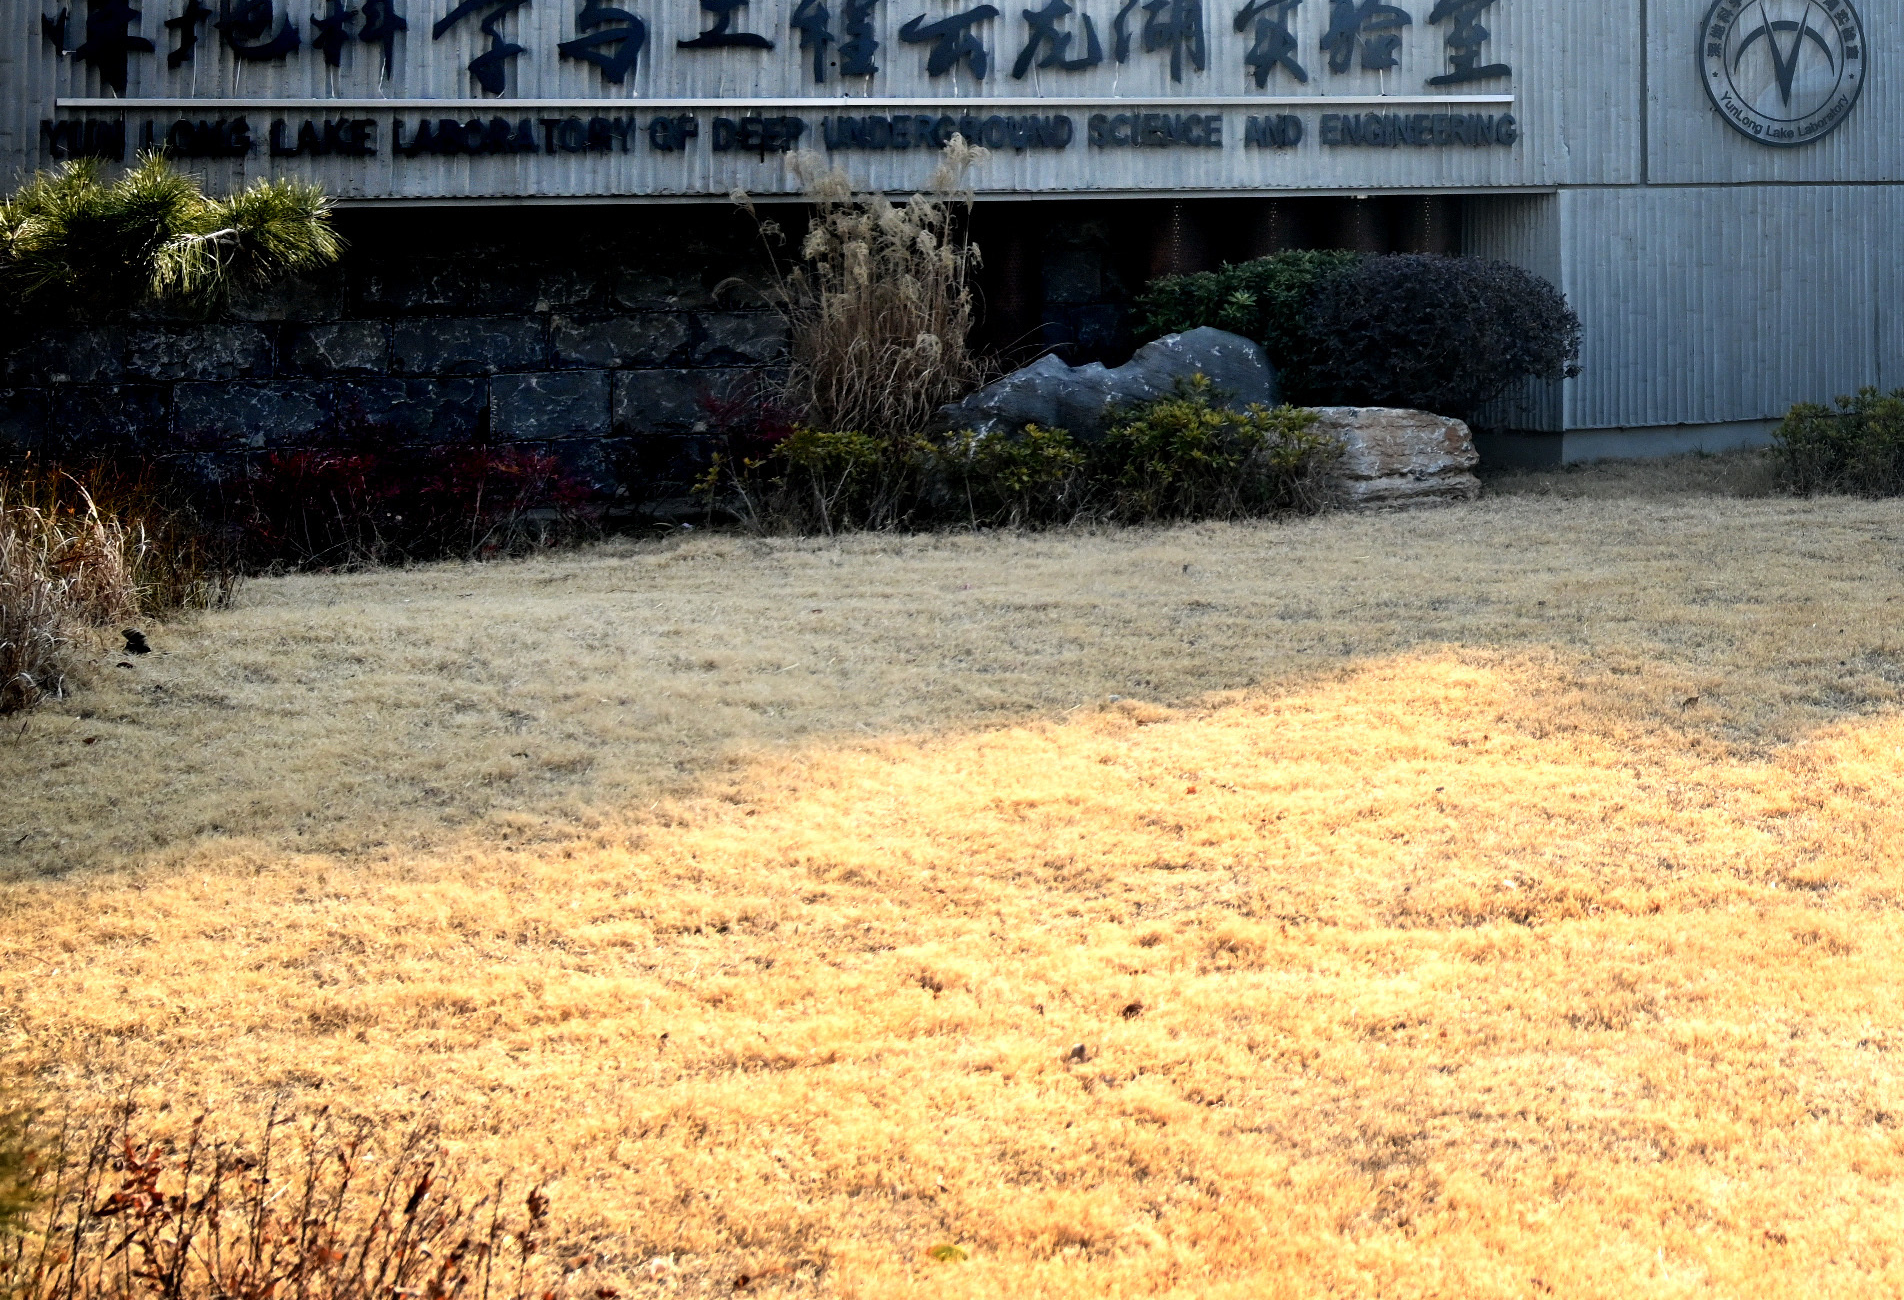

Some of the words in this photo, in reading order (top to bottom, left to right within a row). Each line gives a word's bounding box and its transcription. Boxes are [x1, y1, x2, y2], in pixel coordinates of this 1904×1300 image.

[42, 118, 125, 160] YUN
[140, 117, 250, 157] LONG
[270, 118, 377, 156] LAKE
[393, 116, 636, 155] LABORATORY
[650, 115, 699, 153] OF
[712, 115, 803, 154] DEEP
[823, 114, 1073, 150] UNDERGROUND
[1088, 113, 1223, 148] SCIENCE
[1245, 113, 1303, 147] AND
[1320, 113, 1519, 147] ENGINEERING
[1720, 90, 1764, 135] YunLong
[1766, 124, 1795, 139] Lake
[1798, 93, 1850, 138] Laboratory
